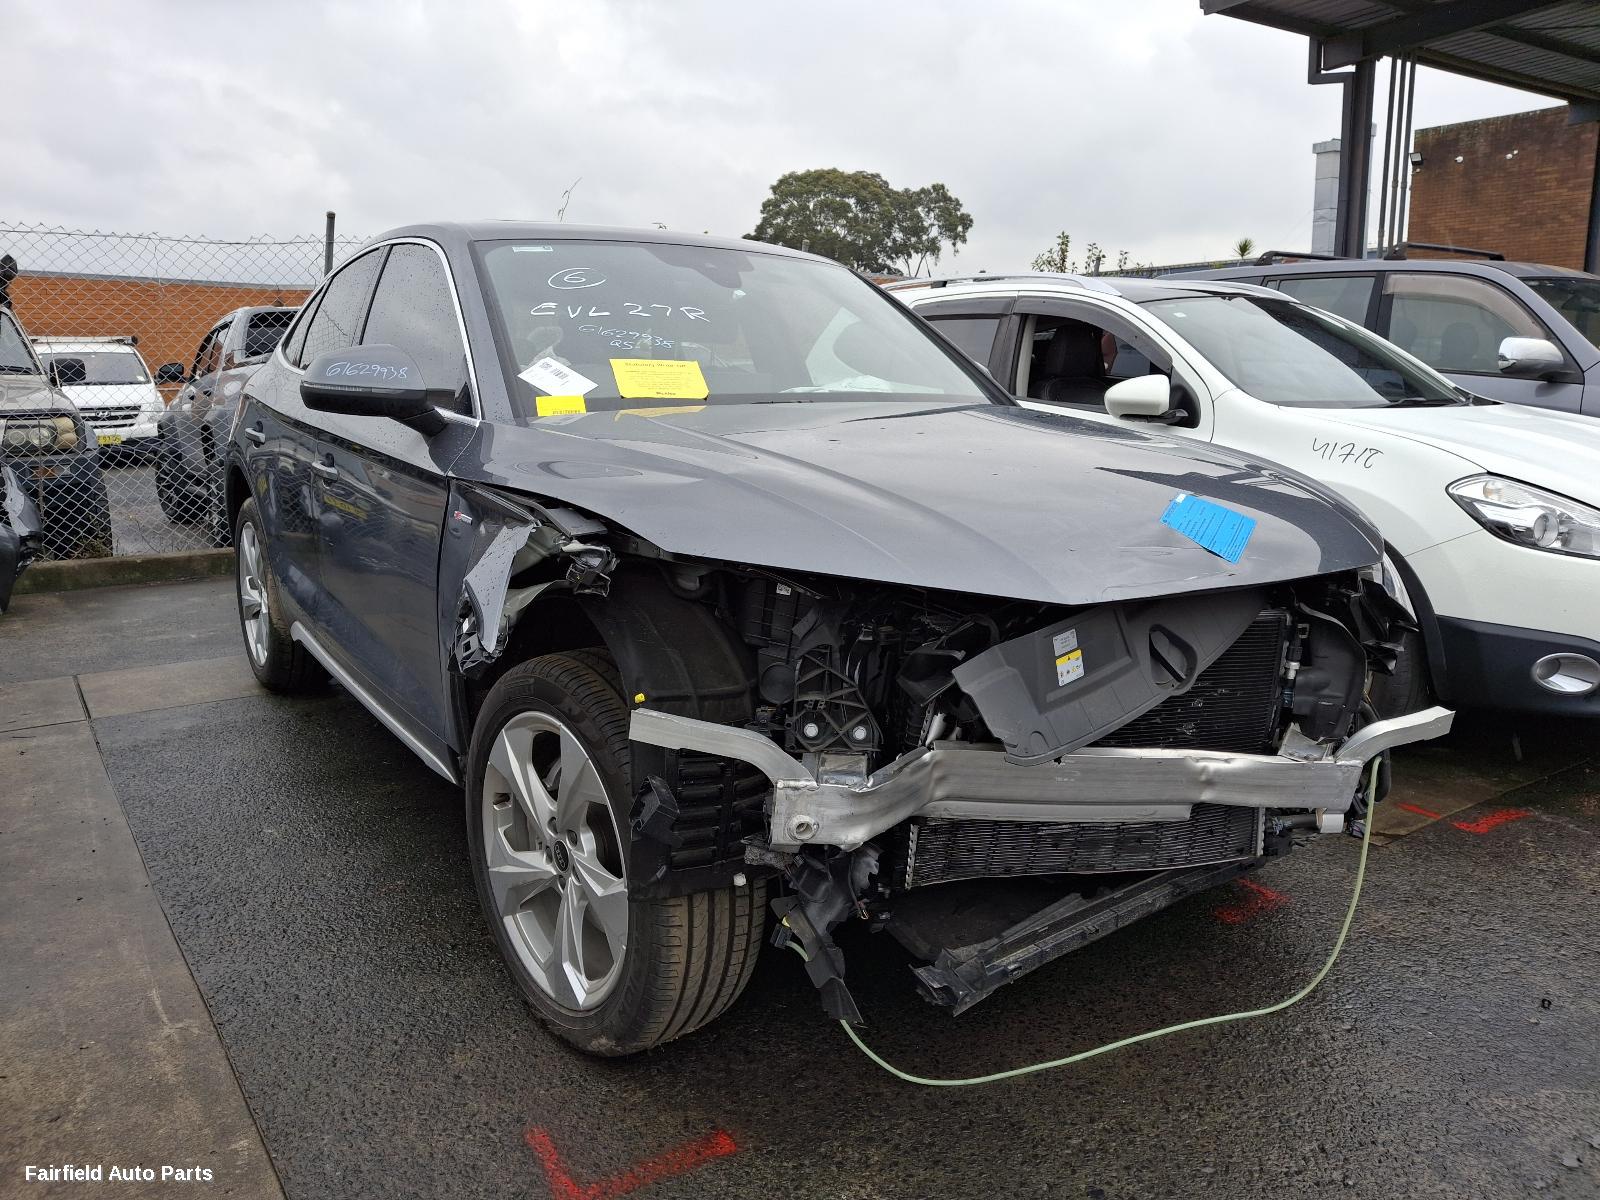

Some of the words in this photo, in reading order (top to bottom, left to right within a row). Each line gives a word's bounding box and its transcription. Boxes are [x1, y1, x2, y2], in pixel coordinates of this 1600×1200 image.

[530, 302, 611, 319] EVL
[623, 302, 711, 323] 27R
[325, 361, 409, 380] 61629938
